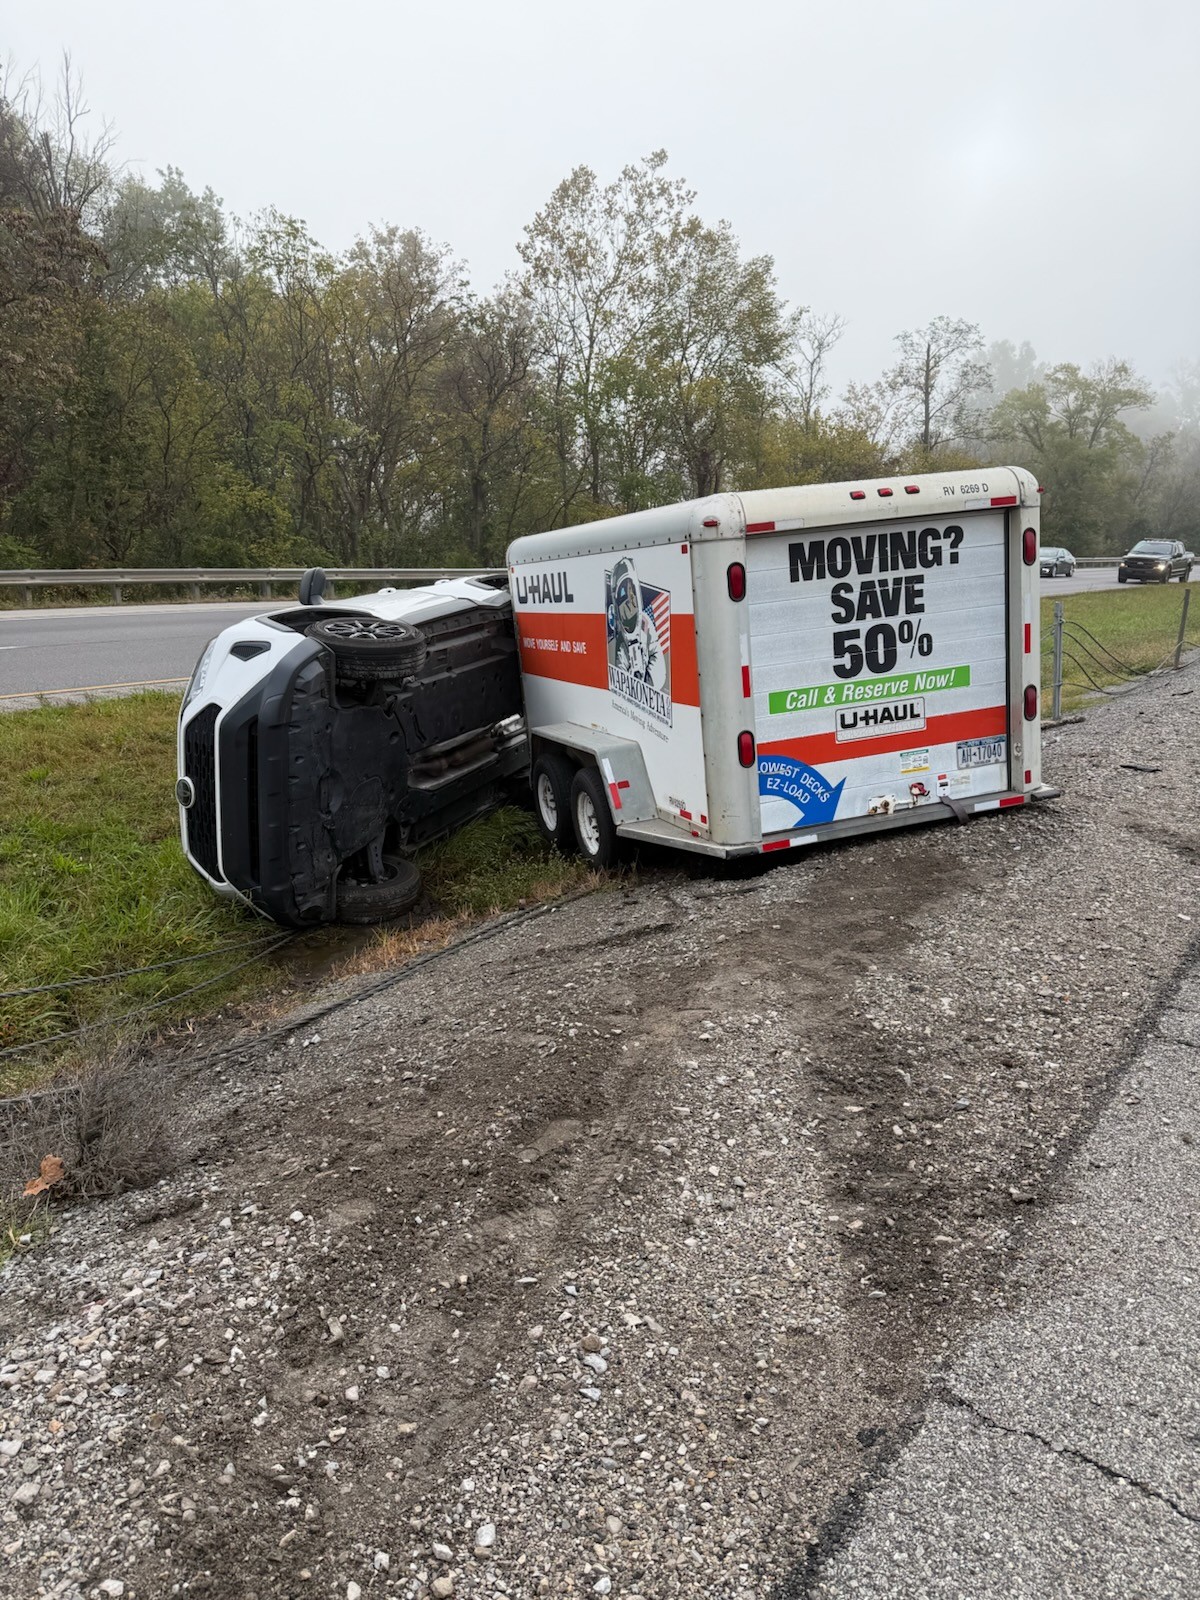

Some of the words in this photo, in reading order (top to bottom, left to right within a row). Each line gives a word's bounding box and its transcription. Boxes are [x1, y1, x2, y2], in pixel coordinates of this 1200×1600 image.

[943, 486, 955, 496] RV
[960, 484, 980, 494] 6269
[981, 483, 989, 493] D
[788, 525, 964, 582] MOVING?
[516, 571, 574, 604] U-HAUL
[831, 574, 925, 624] SAVE
[522, 637, 536, 649] MOVE
[536, 638, 559, 651] YOURSELF
[560, 640, 571, 653] AND
[573, 641, 587, 655] SAVE
[833, 618, 933, 679] 50%
[608, 665, 666, 717] WAPAKONETA
[786, 689, 819, 710] Call
[823, 685, 836, 705] &
[842, 678, 909, 701] Reserve
[914, 669, 956, 691] Now!
[840, 703, 921, 729] U-HAUL
[758, 761, 800, 779] OWEST
[800, 772, 830, 803] DECKS
[766, 777, 811, 804] EZ-LOAD
